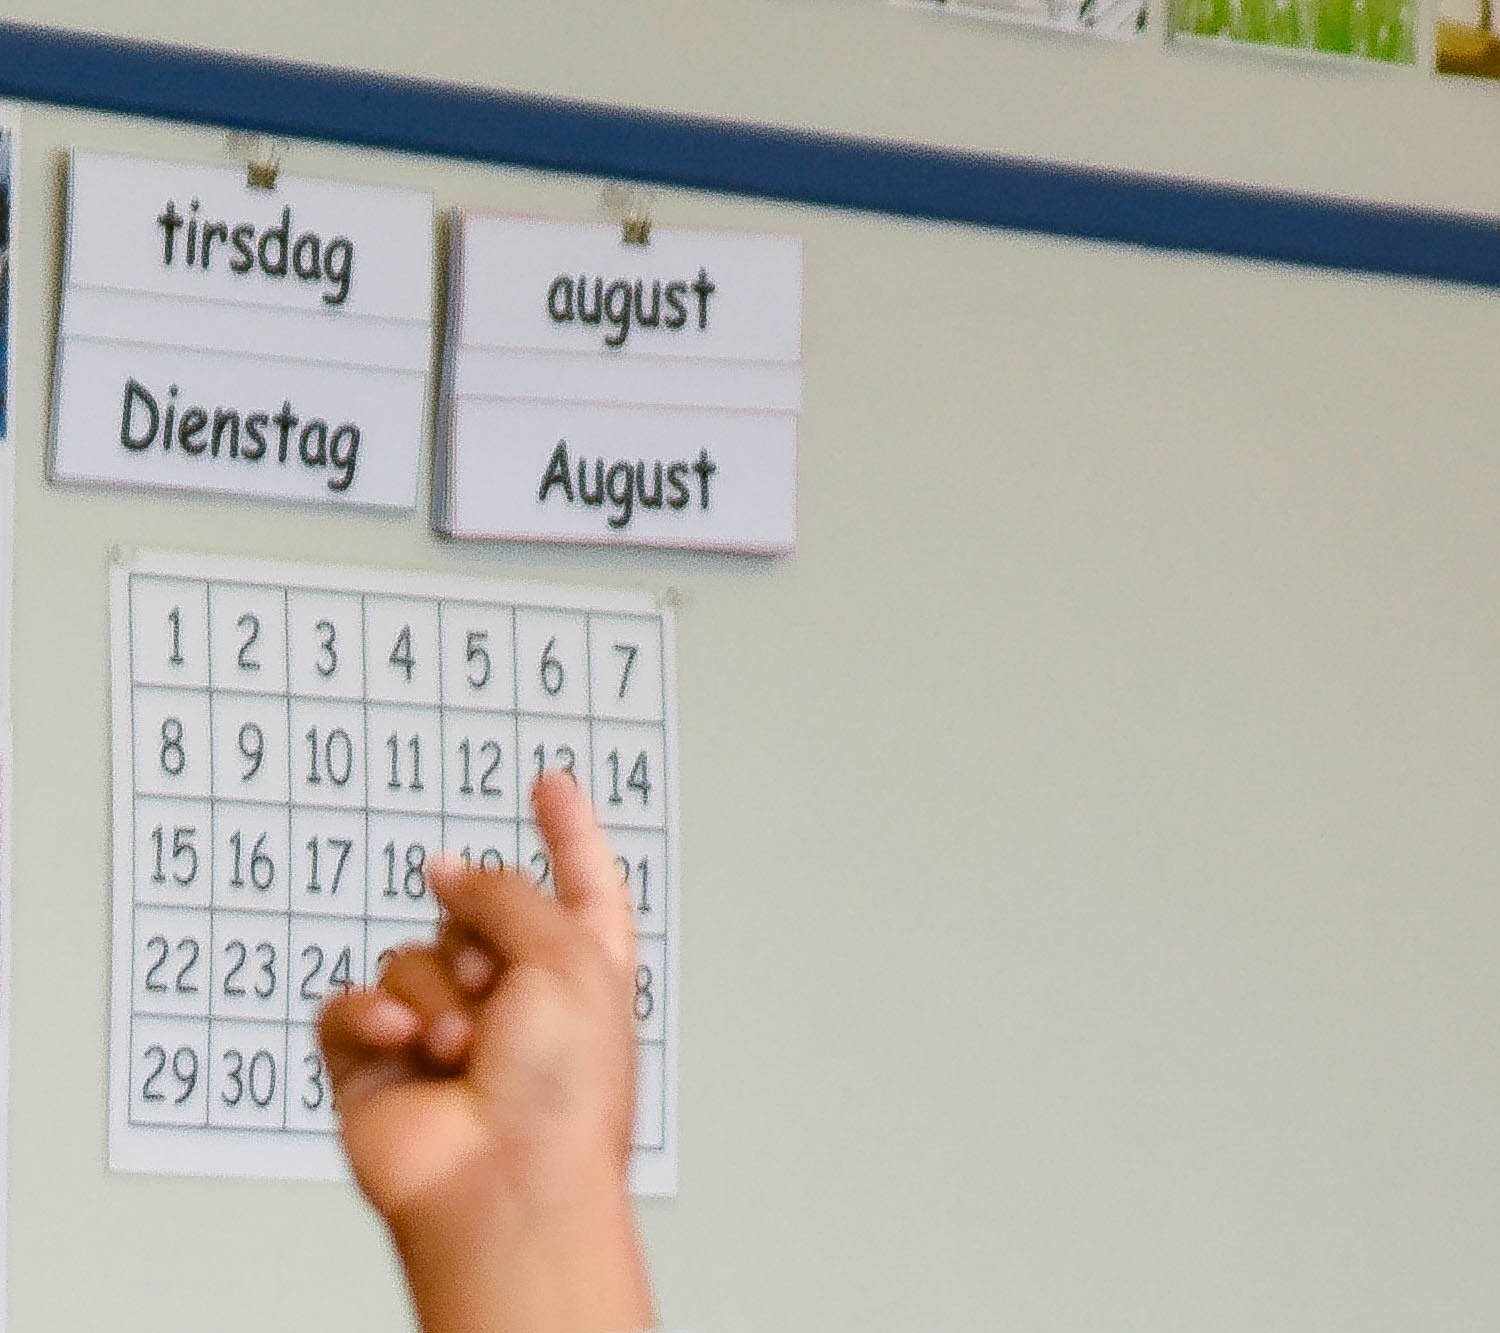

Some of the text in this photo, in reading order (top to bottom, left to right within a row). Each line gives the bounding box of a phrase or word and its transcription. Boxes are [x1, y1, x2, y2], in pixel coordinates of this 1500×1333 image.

[157, 200, 354, 308] tirsdag
[547, 269, 716, 350] august
[120, 379, 361, 493] Dienstag
[538, 441, 717, 530] August
[167, 607, 639, 699] 1 2 3 4 5 6 7
[159, 717, 186, 777] 8
[237, 722, 265, 783] 9
[305, 727, 354, 789] 10
[386, 733, 425, 793] 11
[458, 738, 503, 798] 12
[607, 750, 652, 807] 14
[151, 826, 199, 888] 15
[229, 830, 275, 894] 16
[306, 835, 354, 895] 17
[383, 841, 428, 903] 18
[144, 935, 654, 1023] 22 23 24 8
[142, 1045, 199, 1106] 29
[221, 1049, 277, 1109] 30
